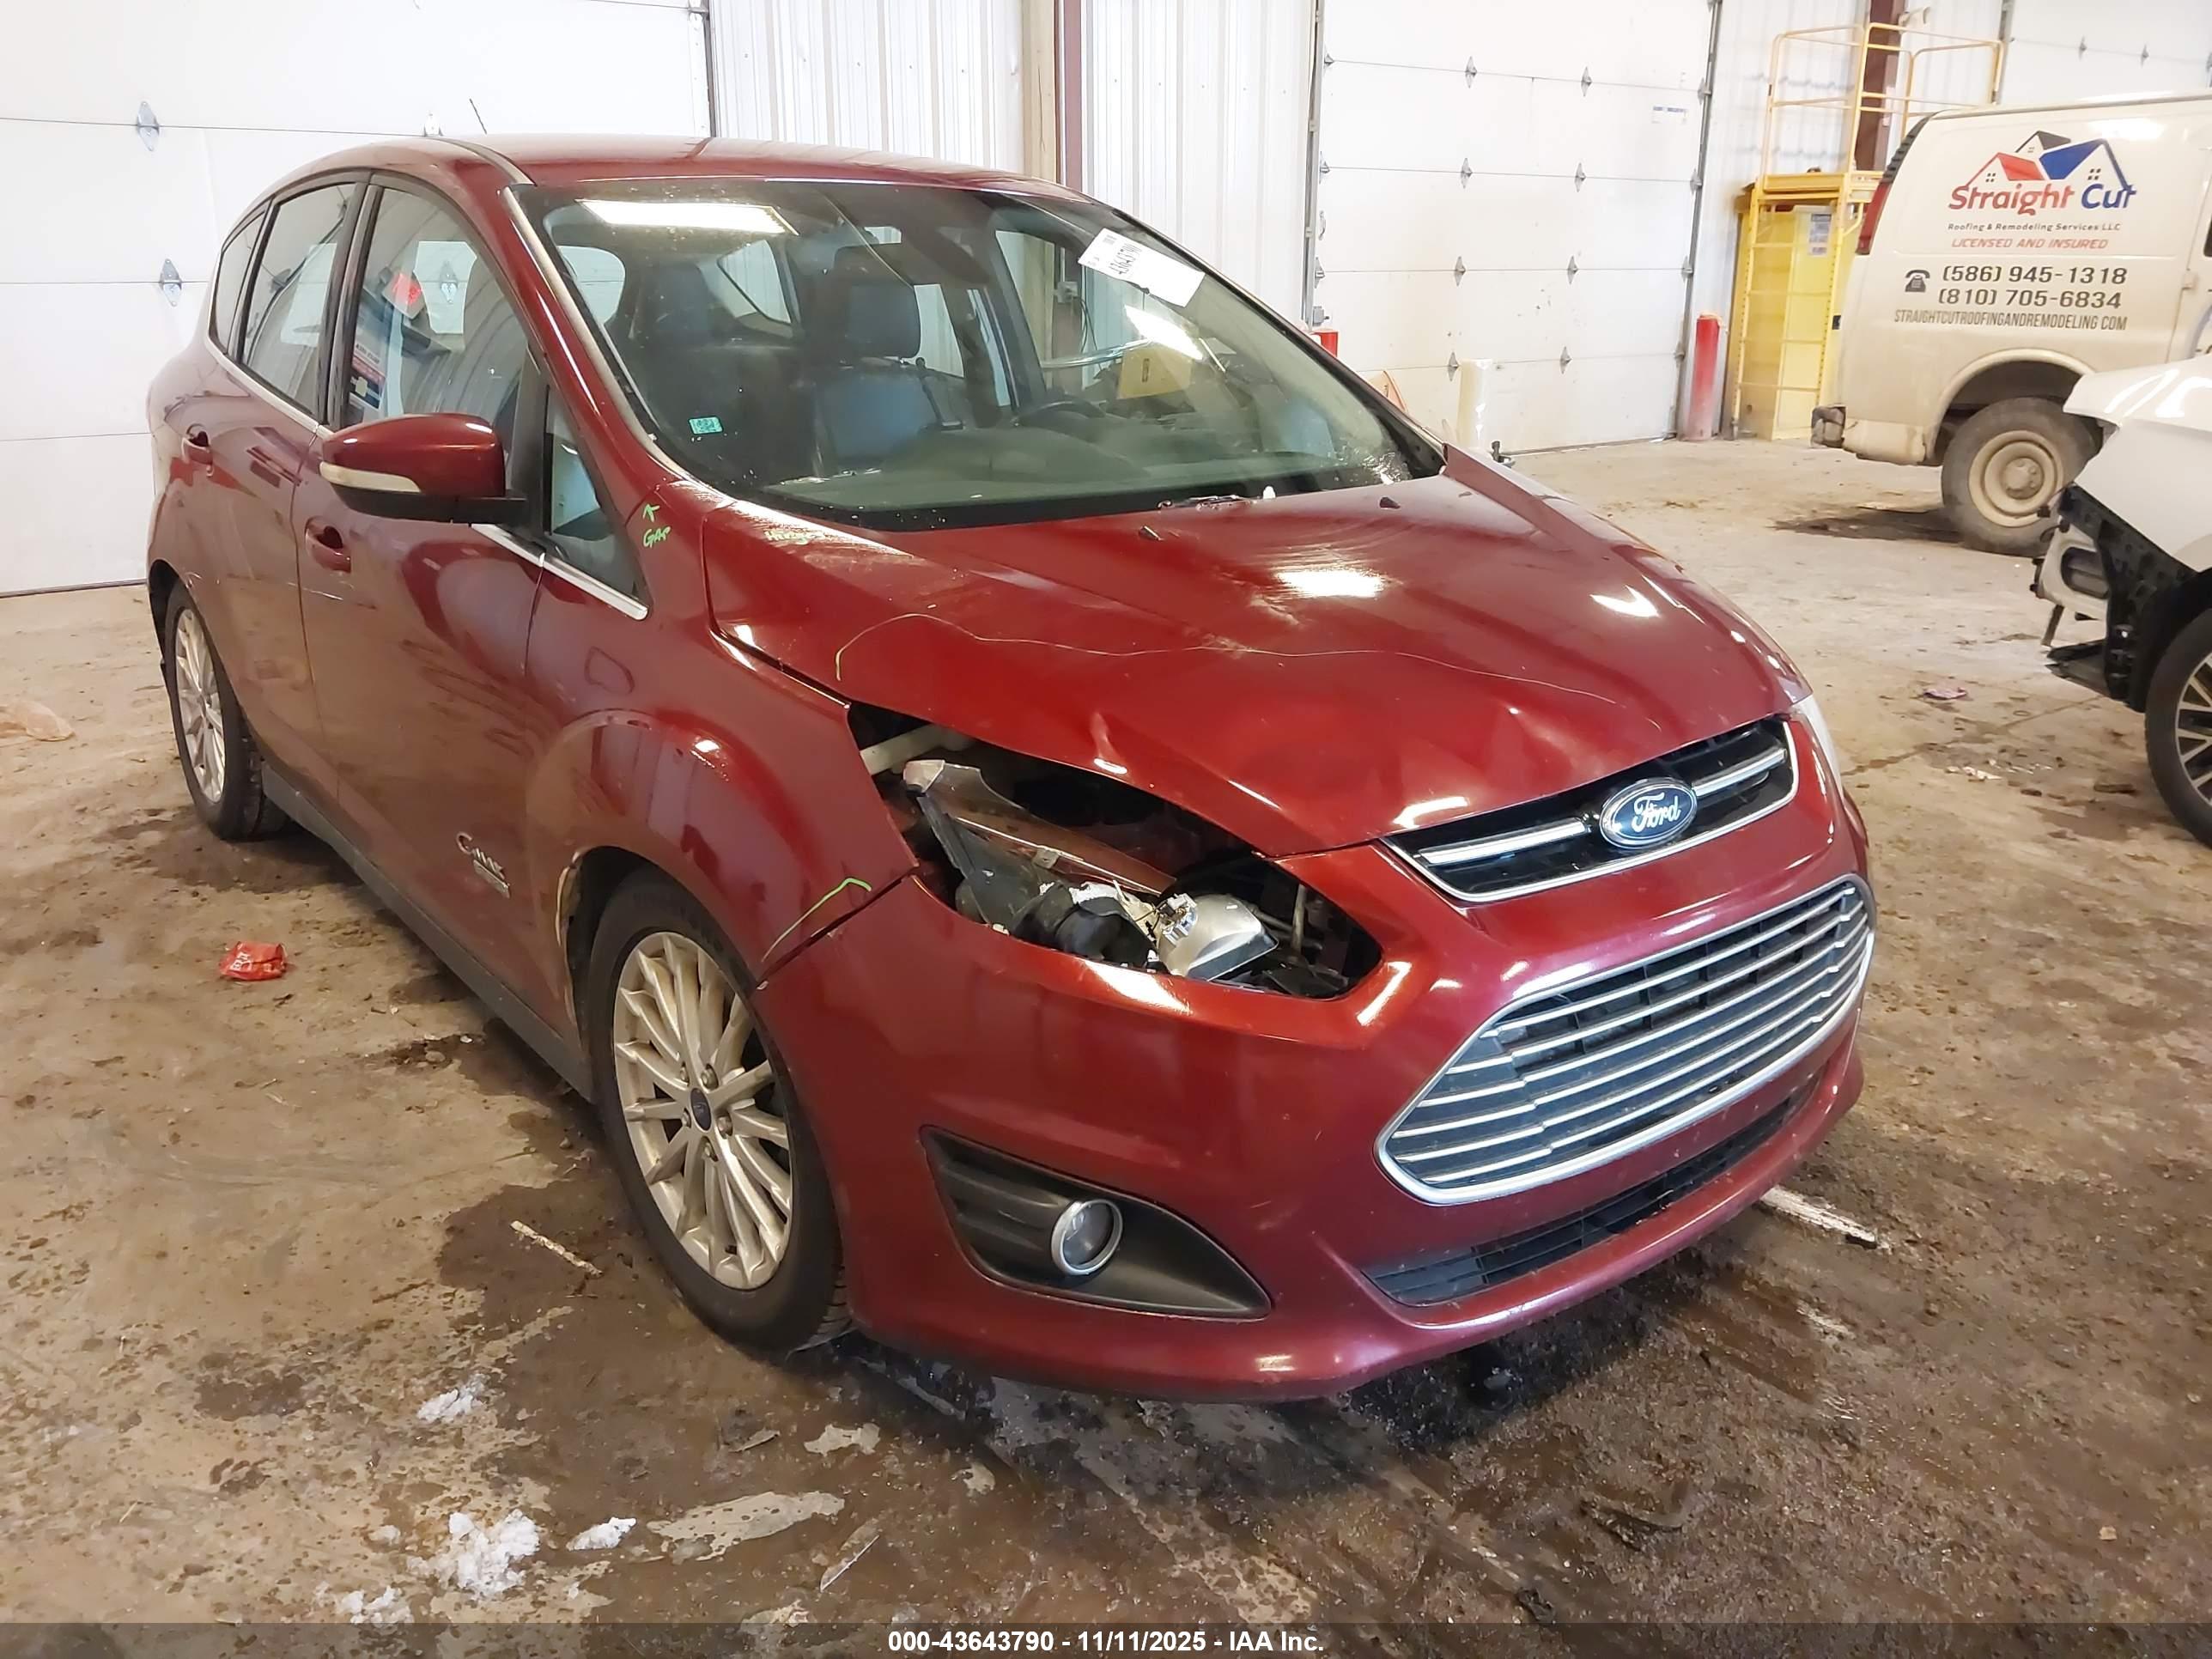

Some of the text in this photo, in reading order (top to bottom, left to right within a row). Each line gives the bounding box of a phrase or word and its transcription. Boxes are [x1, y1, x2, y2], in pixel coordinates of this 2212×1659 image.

[1948, 183, 2137, 216] Straight Cut
[1948, 223, 1985, 232] Roofing
[1996, 223, 2054, 232] Remodeling
[1951, 238, 2109, 249] LICENSED AND INSURED
[1942, 265, 2128, 284] (586) 945-1318
[1938, 288, 2122, 309] (810) 705-6834
[1893, 308, 2128, 331] STRAIGHTCUTROOFINGANDREMODELINGCOM
[1632, 792, 1681, 833] Ford
